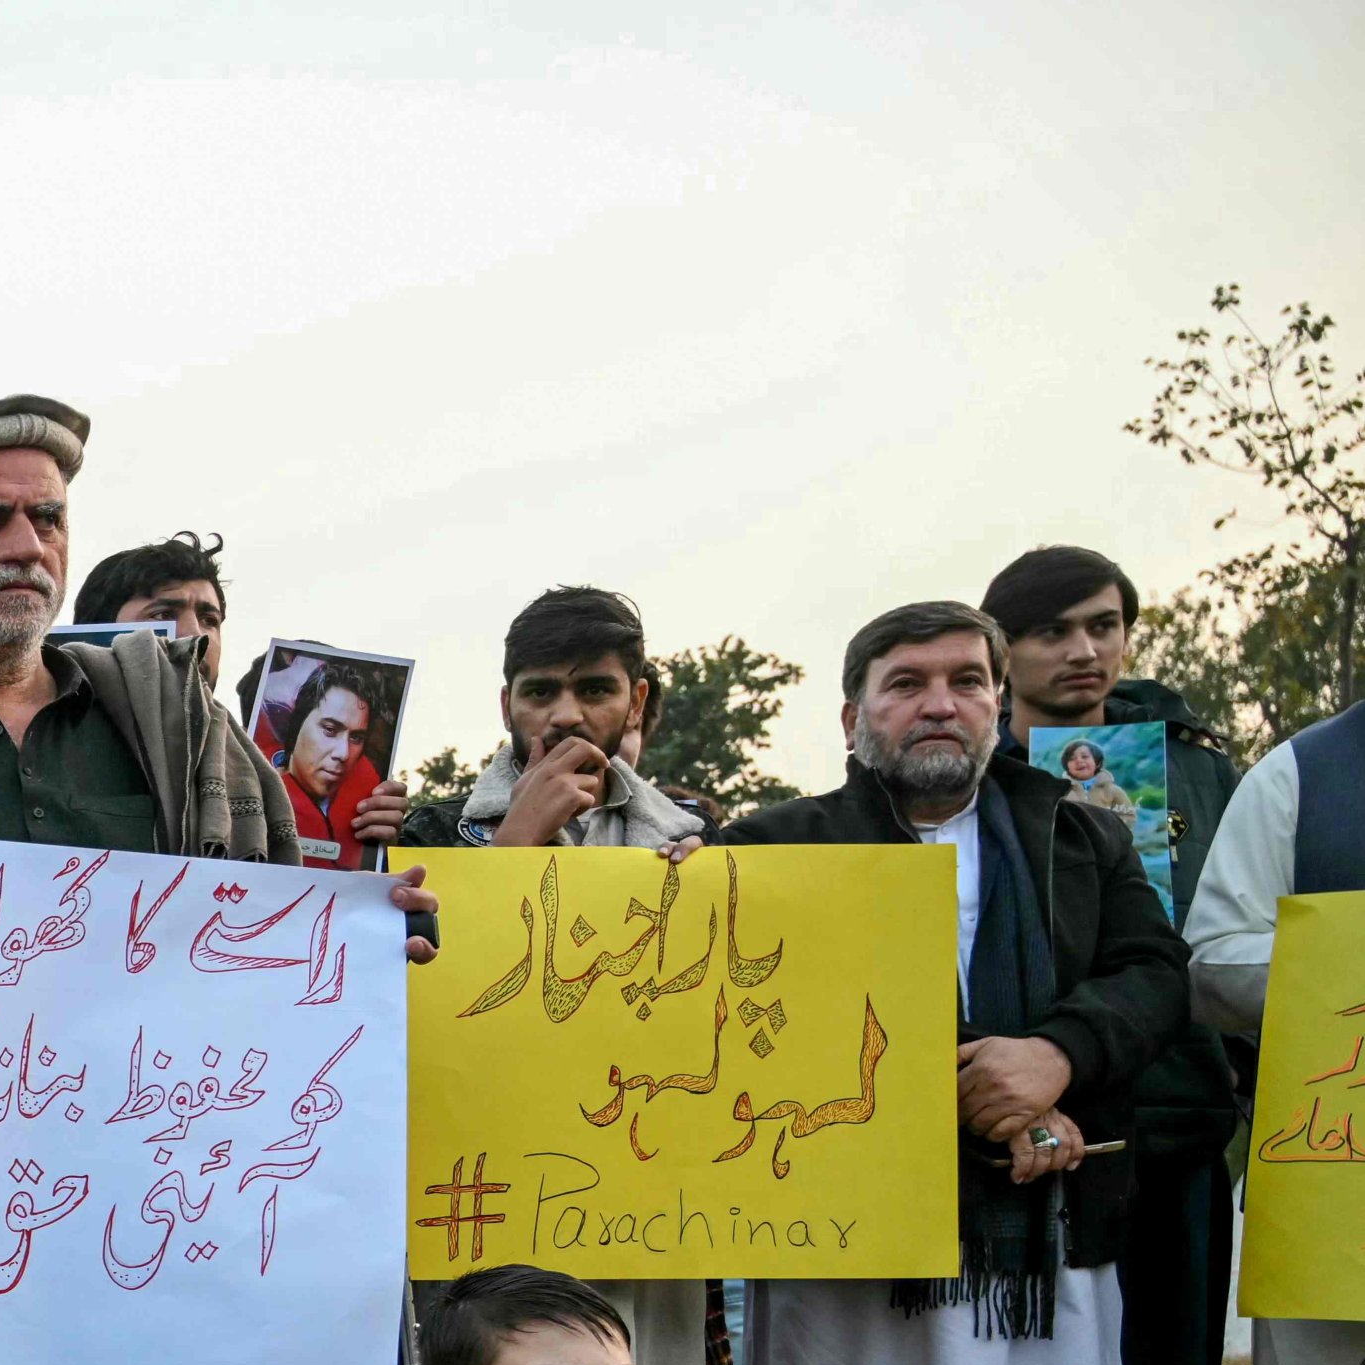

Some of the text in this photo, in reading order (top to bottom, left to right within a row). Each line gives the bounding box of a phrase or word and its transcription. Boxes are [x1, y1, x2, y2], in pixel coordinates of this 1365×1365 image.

[127, 860, 189, 975] کا
[190, 882, 346, 1006] راستے
[456, 849, 788, 1060] پاراچنار
[105, 1025, 269, 1143] محفوظ
[262, 1024, 364, 1152] کو
[579, 982, 888, 1180] لہو لہو
